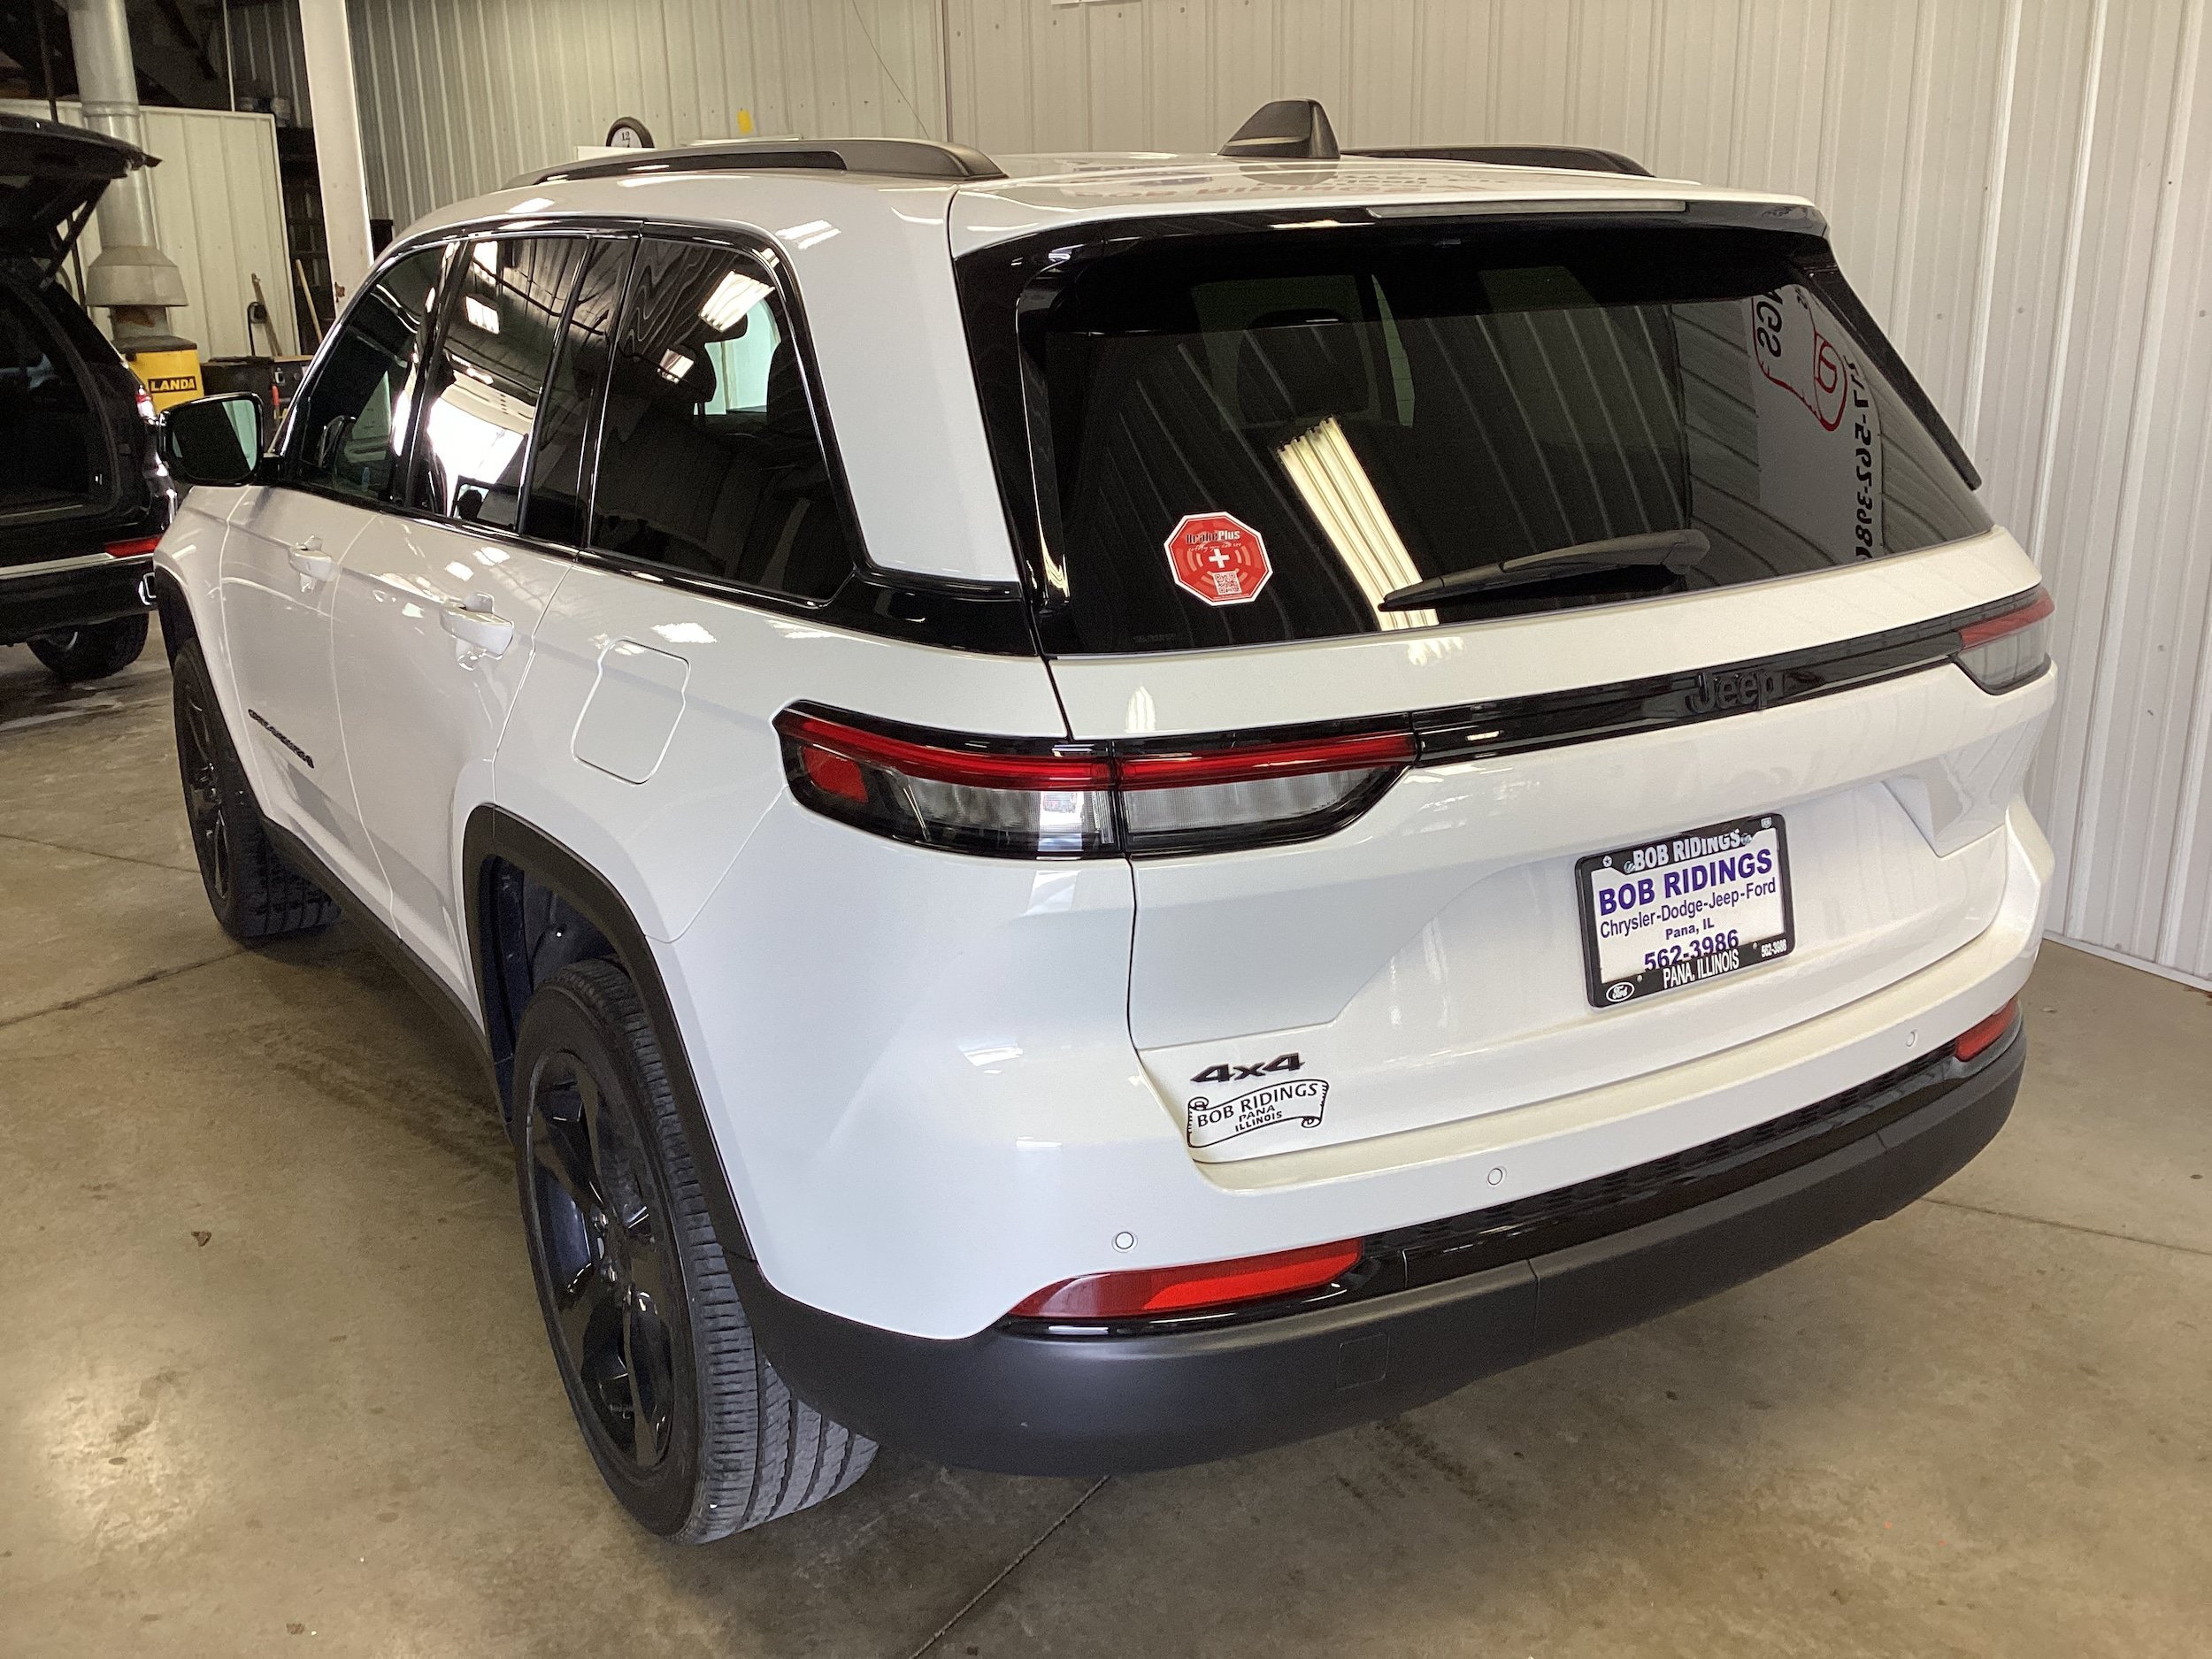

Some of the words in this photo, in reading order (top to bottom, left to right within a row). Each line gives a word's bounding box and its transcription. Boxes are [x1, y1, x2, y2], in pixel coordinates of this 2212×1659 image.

[622, 131, 630, 141] 12
[150, 379, 196, 391] LANDA
[1685, 670, 1785, 714] Jeep
[1632, 849, 1670, 872] BOB
[1673, 829, 1740, 863] RIDINGS
[1599, 878, 1655, 917] BOB
[1663, 849, 1773, 898] RIDINGS
[1601, 877, 1777, 939] Chrysler-Dodge-Jeep-Ford
[1665, 925, 1700, 941] Pana,
[1702, 918, 1715, 930] IL
[1644, 929, 1740, 971] 562-3986
[1698, 949, 1740, 979] ILLINOIS
[1190, 1052, 1306, 1083] 4x4
[1197, 1105, 1235, 1128] BOB
[1240, 1083, 1318, 1113] RIDINGS
[1238, 1104, 1276, 1123] PANA
[1234, 1110, 1283, 1133] ILLINOIS
